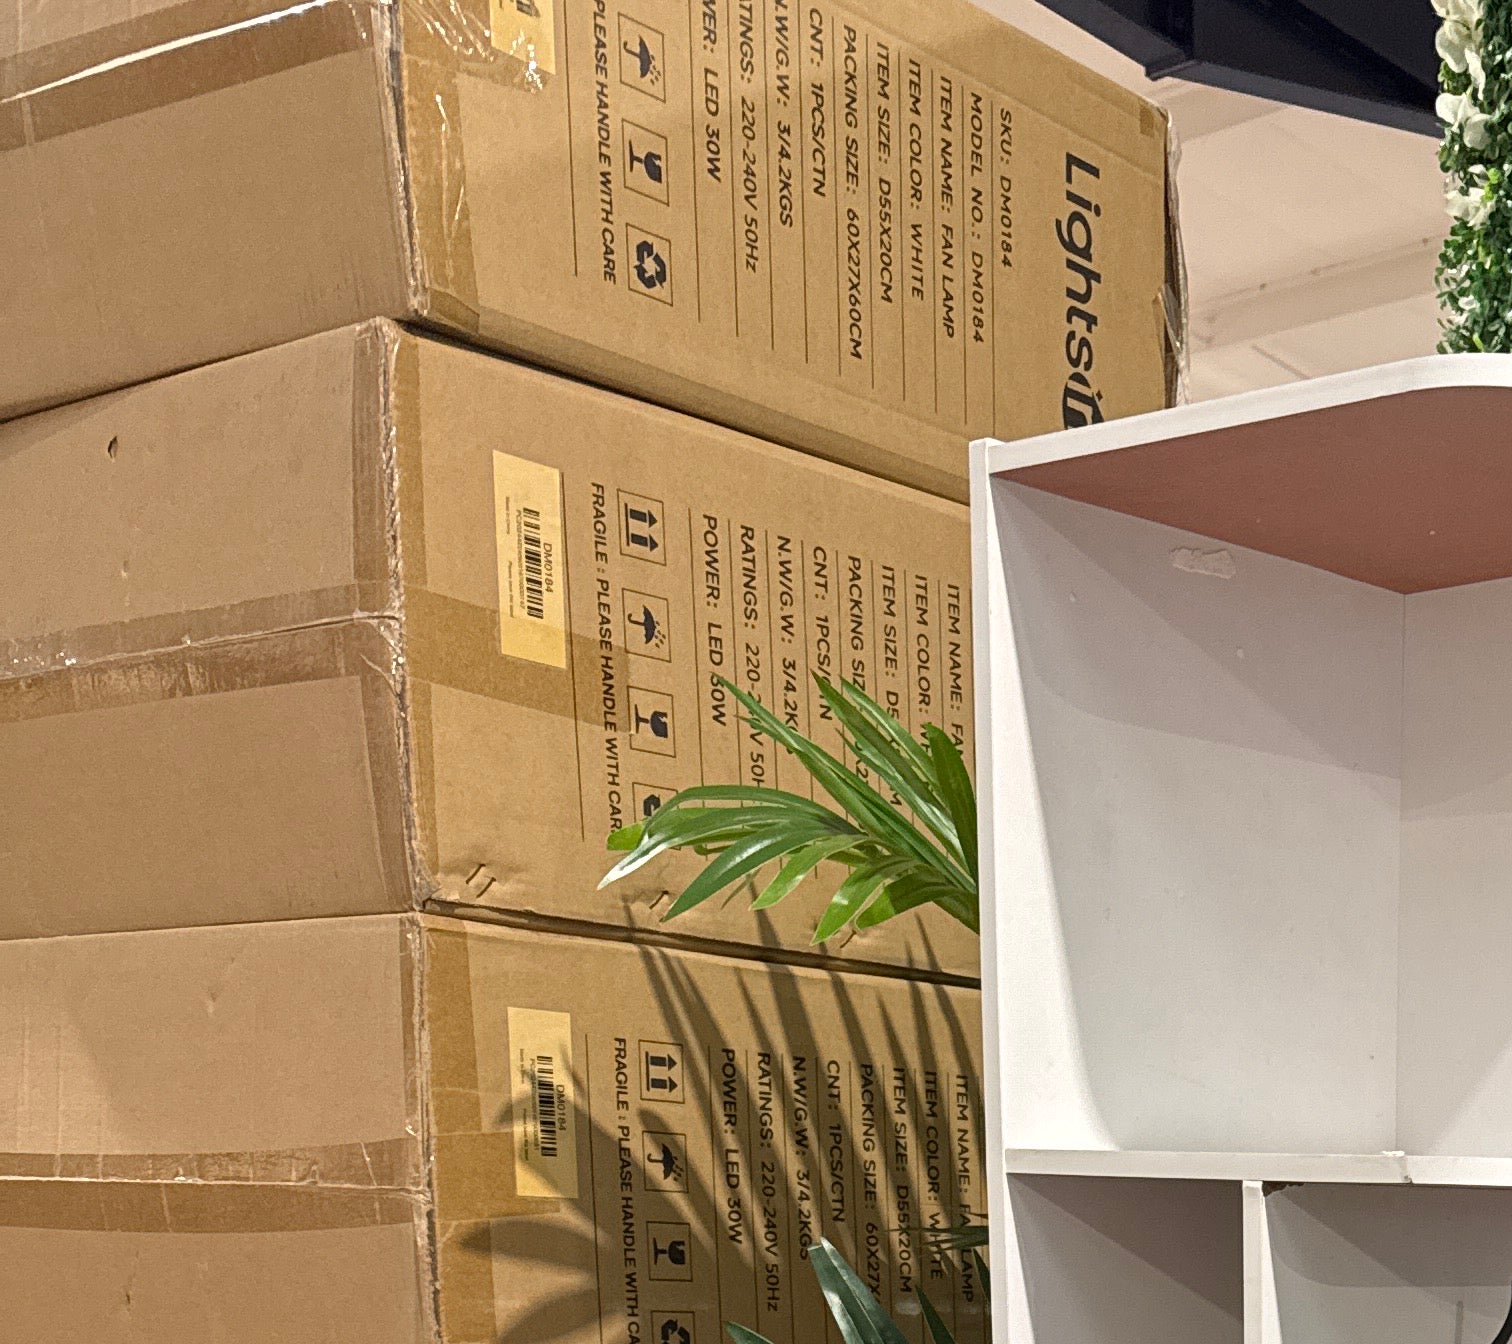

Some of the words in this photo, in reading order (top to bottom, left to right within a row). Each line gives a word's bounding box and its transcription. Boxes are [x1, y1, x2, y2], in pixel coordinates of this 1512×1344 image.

[809, 7, 823, 67] CNT:
[703, 67, 719, 117] LED
[843, 24, 857, 128] PACKING
[876, 42, 889, 100] ITEM
[908, 58, 921, 116] ITEM
[595, 81, 612, 166] HANDLE
[877, 105, 890, 165] SIZE:
[940, 76, 952, 132] ITEM
[970, 92, 983, 177] MODEL
[1000, 108, 1012, 165] SKU:
[706, 124, 722, 183] 30W
[741, 96, 758, 211] 220-240V
[811, 82, 826, 197] 1PCS/CTN
[845, 135, 858, 194] SIZE:
[909, 122, 922, 210] COLOR:
[600, 170, 613, 225] WITH
[778, 120, 793, 228] 3/4.2KGS
[940, 137, 953, 213] NAME:
[745, 214, 758, 273] 50Hz
[879, 177, 893, 303] D55X20CM
[971, 187, 983, 240] NO.:
[1000, 175, 1012, 268] DM0184
[602, 228, 616, 284] CARE
[911, 223, 924, 301] WHITE
[941, 224, 954, 269] FAN
[847, 208, 862, 360] 60X27X60CM
[942, 275, 955, 339] LAMP
[972, 251, 984, 343] DM0184
[591, 482, 608, 563] FRAGILE
[543, 542, 554, 593] DM0184
[703, 514, 720, 608] POWER:
[740, 524, 758, 629] RATINGS:
[778, 536, 795, 644] N.W/G.W:
[813, 546, 828, 600] CNT:
[882, 565, 896, 616] ITEM
[597, 578, 612, 650] PLEASE
[848, 555, 864, 651] PACKING
[915, 574, 928, 629] ITEM
[947, 584, 960, 637] ITEM
[707, 621, 723, 666] LED
[884, 624, 898, 677] SIZE:
[916, 633, 930, 714] COLOR:
[949, 641, 962, 711] NAME:
[600, 655, 616, 731] HANDLE
[605, 737, 619, 785] WITH
[608, 790, 622, 834] CAR
[614, 1038, 627, 1111] FRAGILE
[722, 1048, 737, 1134] POWER:
[757, 1052, 773, 1148] RATINGS:
[793, 1056, 809, 1156] N.W/G.W:
[828, 1060, 841, 1110] CNT:
[893, 1068, 906, 1116] ITEM
[925, 1071, 938, 1121] ITEM
[956, 1074, 968, 1123] ITEM
[861, 1064, 875, 1152] PACKING
[618, 1126, 632, 1192] PLEASE
[725, 1148, 740, 1189] LED
[829, 1124, 845, 1222] 1PCS/CTN
[894, 1121, 908, 1173] SIZE:
[926, 1126, 940, 1201] COLOR:
[957, 1128, 970, 1194] NAME:
[761, 1161, 778, 1257] 220-240V
[863, 1159, 877, 1211] SIZE:
[621, 1197, 637, 1267] HANDLE
[727, 1197, 742, 1244] 30W
[896, 1185, 912, 1293] D55X20CM
[625, 1272, 639, 1317] WITH
[765, 1264, 780, 1312] 50Hz
